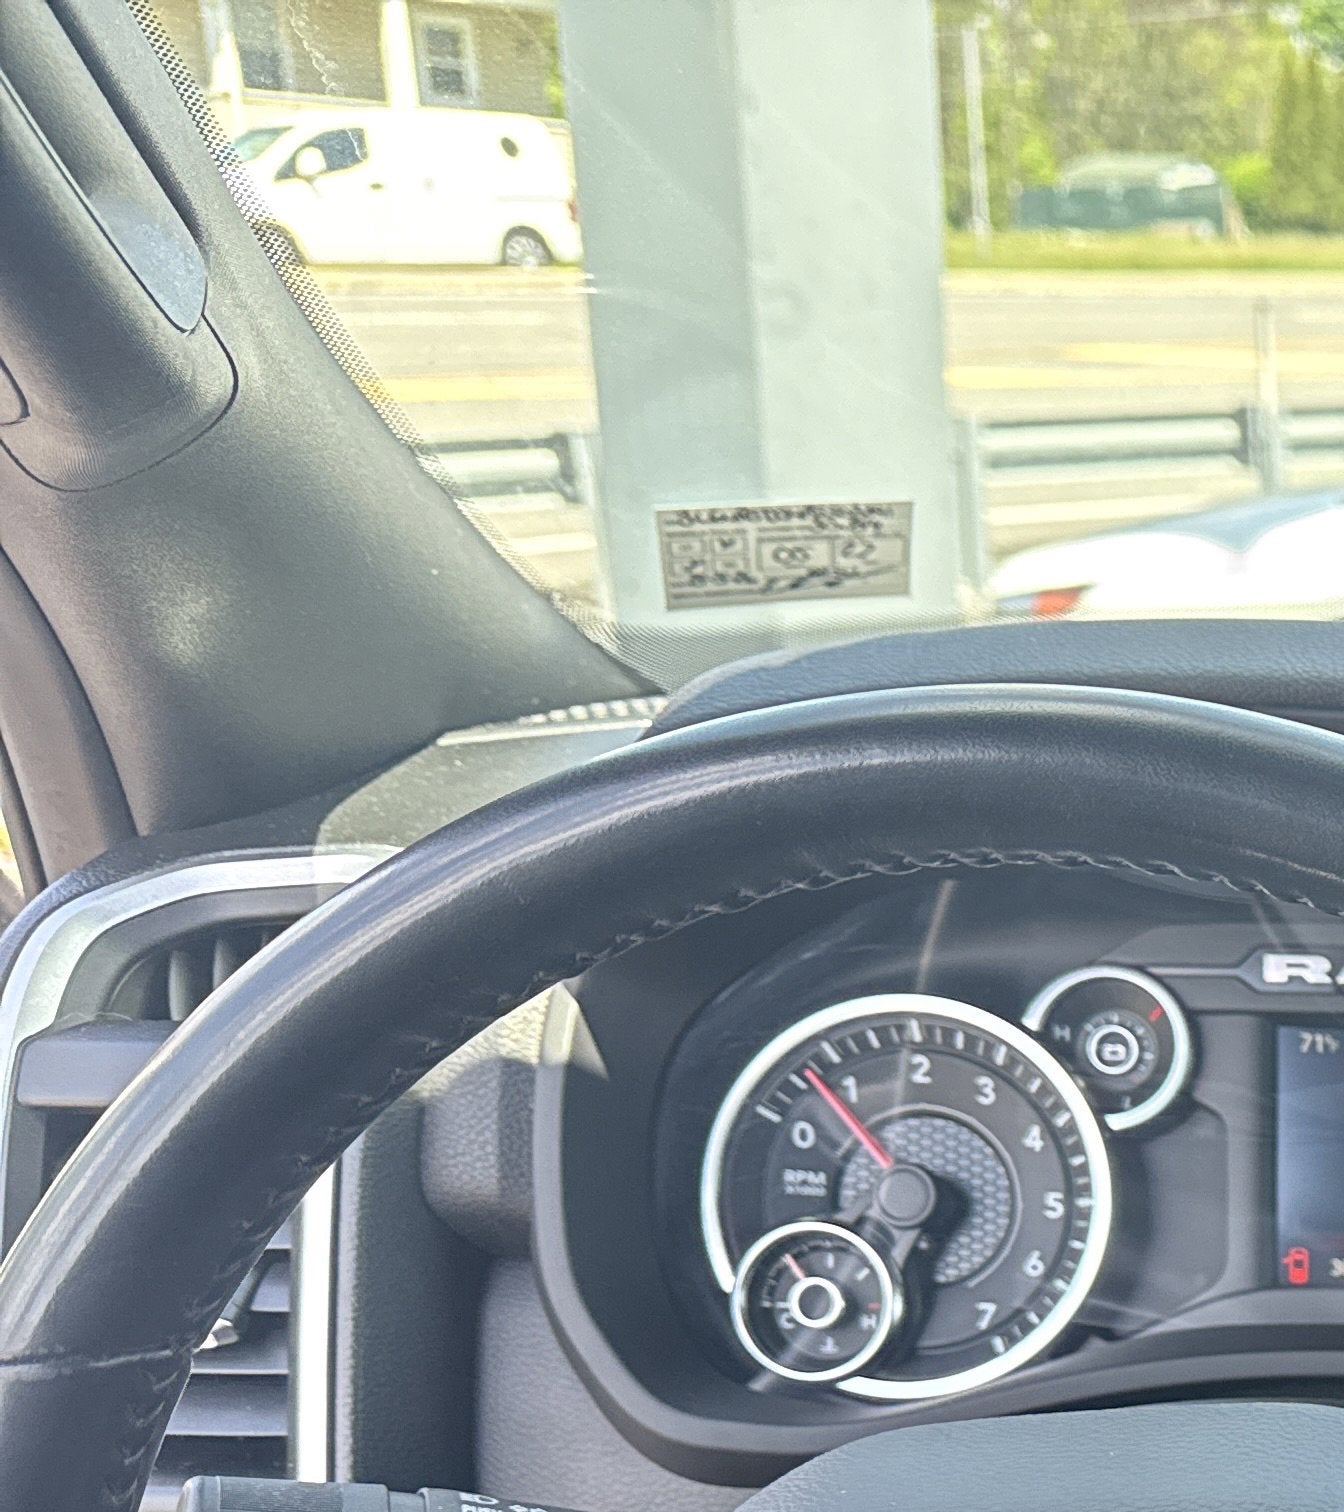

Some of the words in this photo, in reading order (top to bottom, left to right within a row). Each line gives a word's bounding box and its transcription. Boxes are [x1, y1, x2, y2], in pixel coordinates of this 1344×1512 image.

[910, 1057, 931, 1084] 2
[842, 1077, 857, 1102] 1
[975, 1076, 996, 1103] 3
[794, 1121, 815, 1149] 0
[1023, 1124, 1044, 1152] 4
[783, 1169, 827, 1184] RPM
[1044, 1191, 1064, 1219] 5
[1024, 1251, 1045, 1277] 6
[975, 1303, 997, 1330] 7
